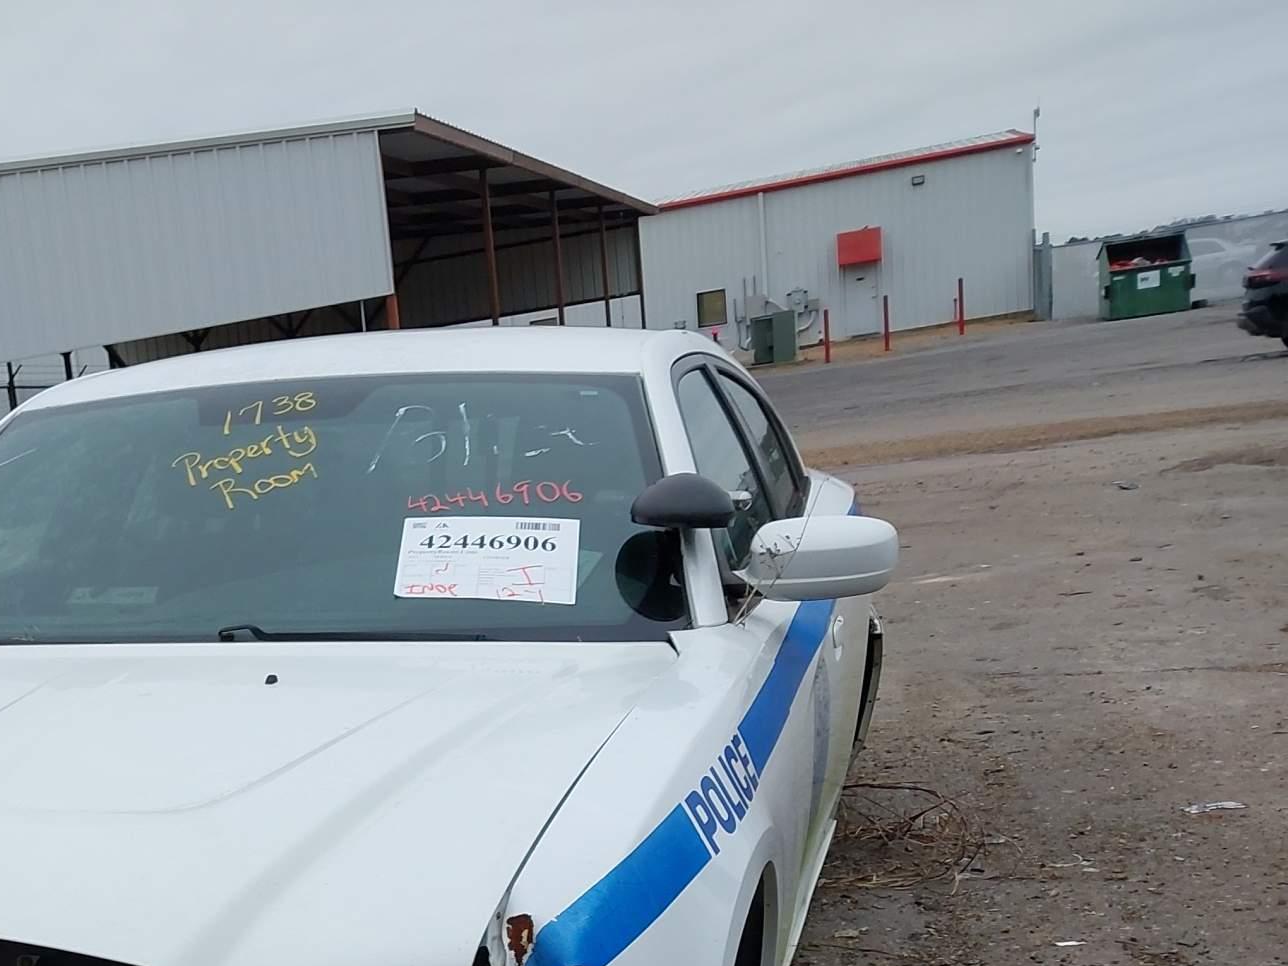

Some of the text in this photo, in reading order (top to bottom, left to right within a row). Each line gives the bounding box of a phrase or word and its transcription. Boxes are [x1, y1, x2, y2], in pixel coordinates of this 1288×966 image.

[223, 391, 317, 435] 1738
[171, 424, 317, 486] Property
[209, 462, 318, 509] Room
[407, 479, 584, 512] 42446906
[419, 534, 558, 552] 42446906
[684, 734, 759, 856] POLICE
